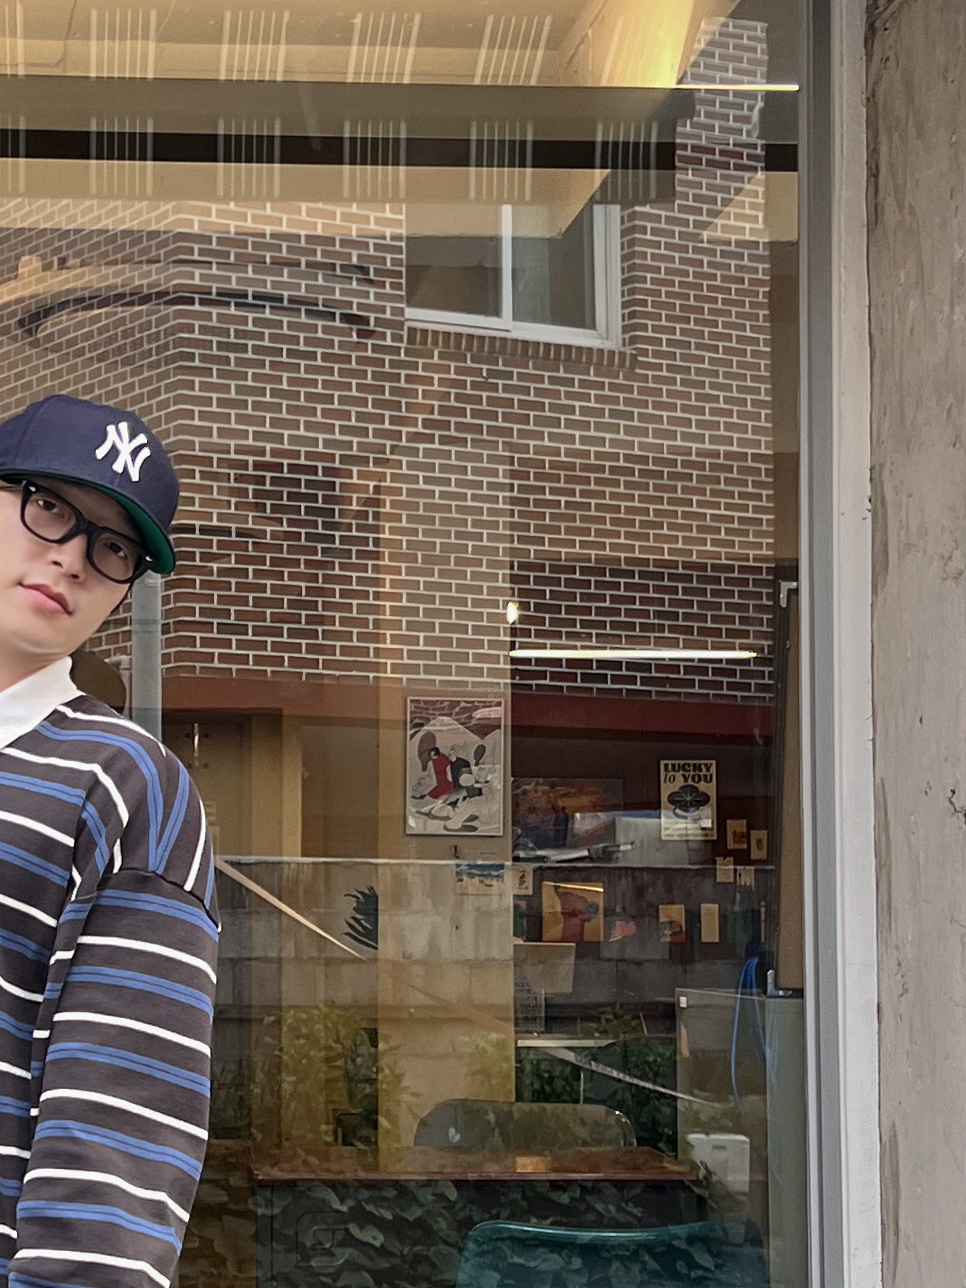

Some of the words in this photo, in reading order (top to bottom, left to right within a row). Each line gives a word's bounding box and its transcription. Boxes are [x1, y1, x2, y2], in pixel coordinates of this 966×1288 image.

[95, 421, 151, 482] NY
[663, 762, 713, 773] LUCKY
[681, 773, 713, 784] YOU
